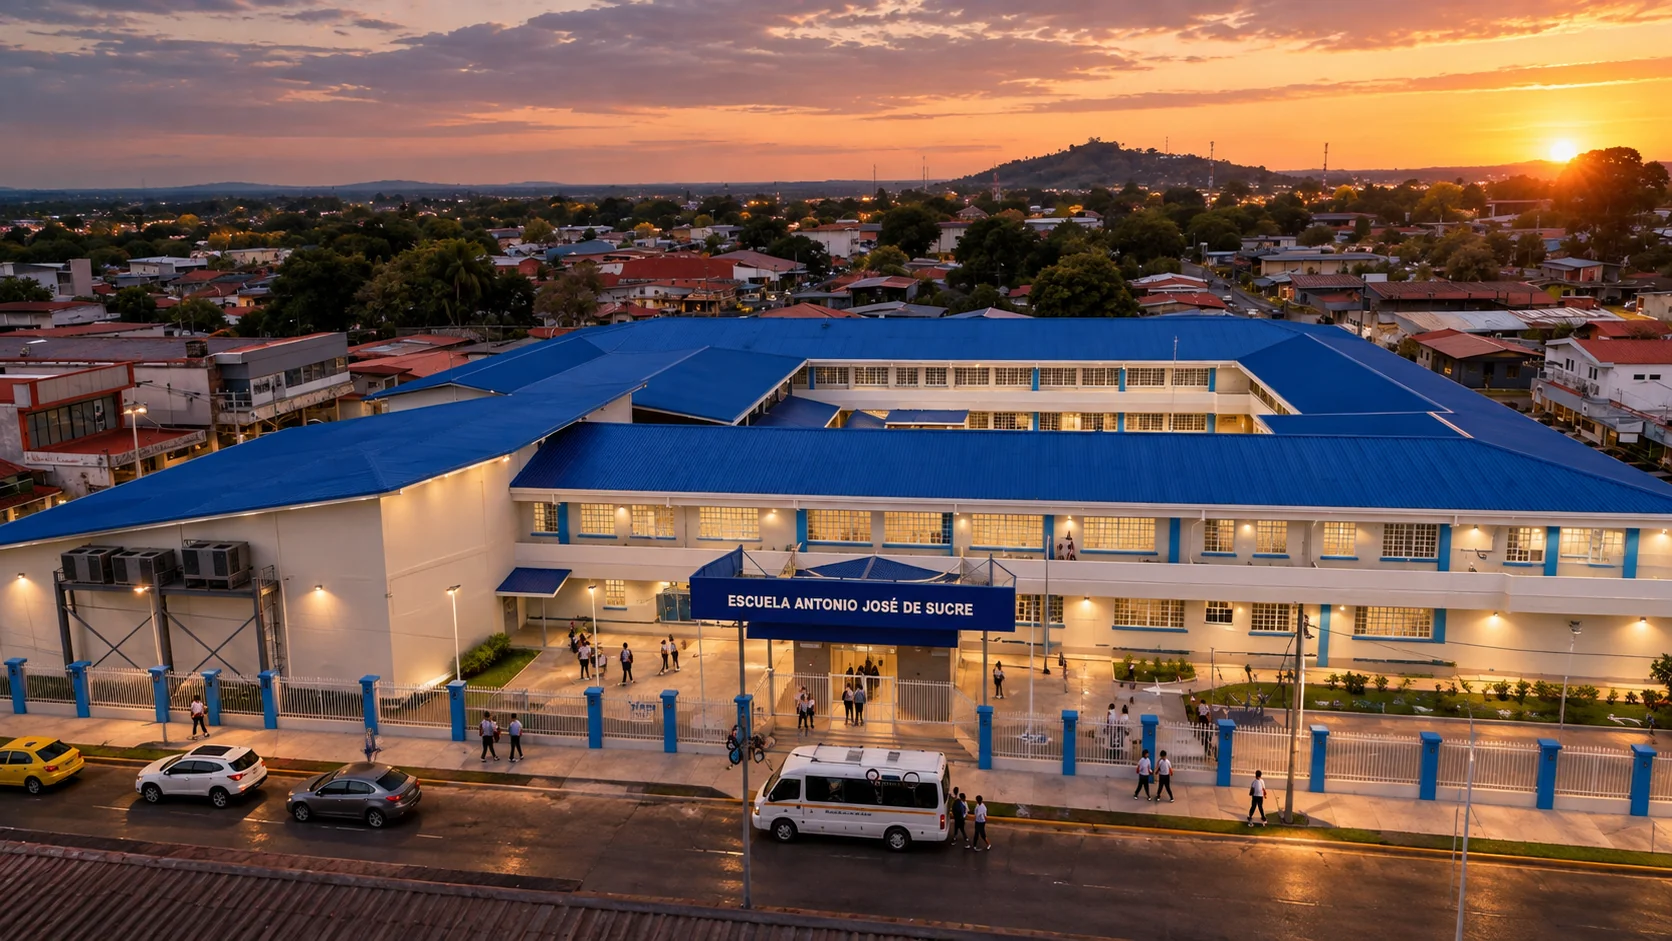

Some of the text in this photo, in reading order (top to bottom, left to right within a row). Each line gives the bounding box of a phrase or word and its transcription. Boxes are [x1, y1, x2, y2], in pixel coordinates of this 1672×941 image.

[728, 595, 973, 616] ESCUELA ANTONIO JOSÉ DE SUCRE
